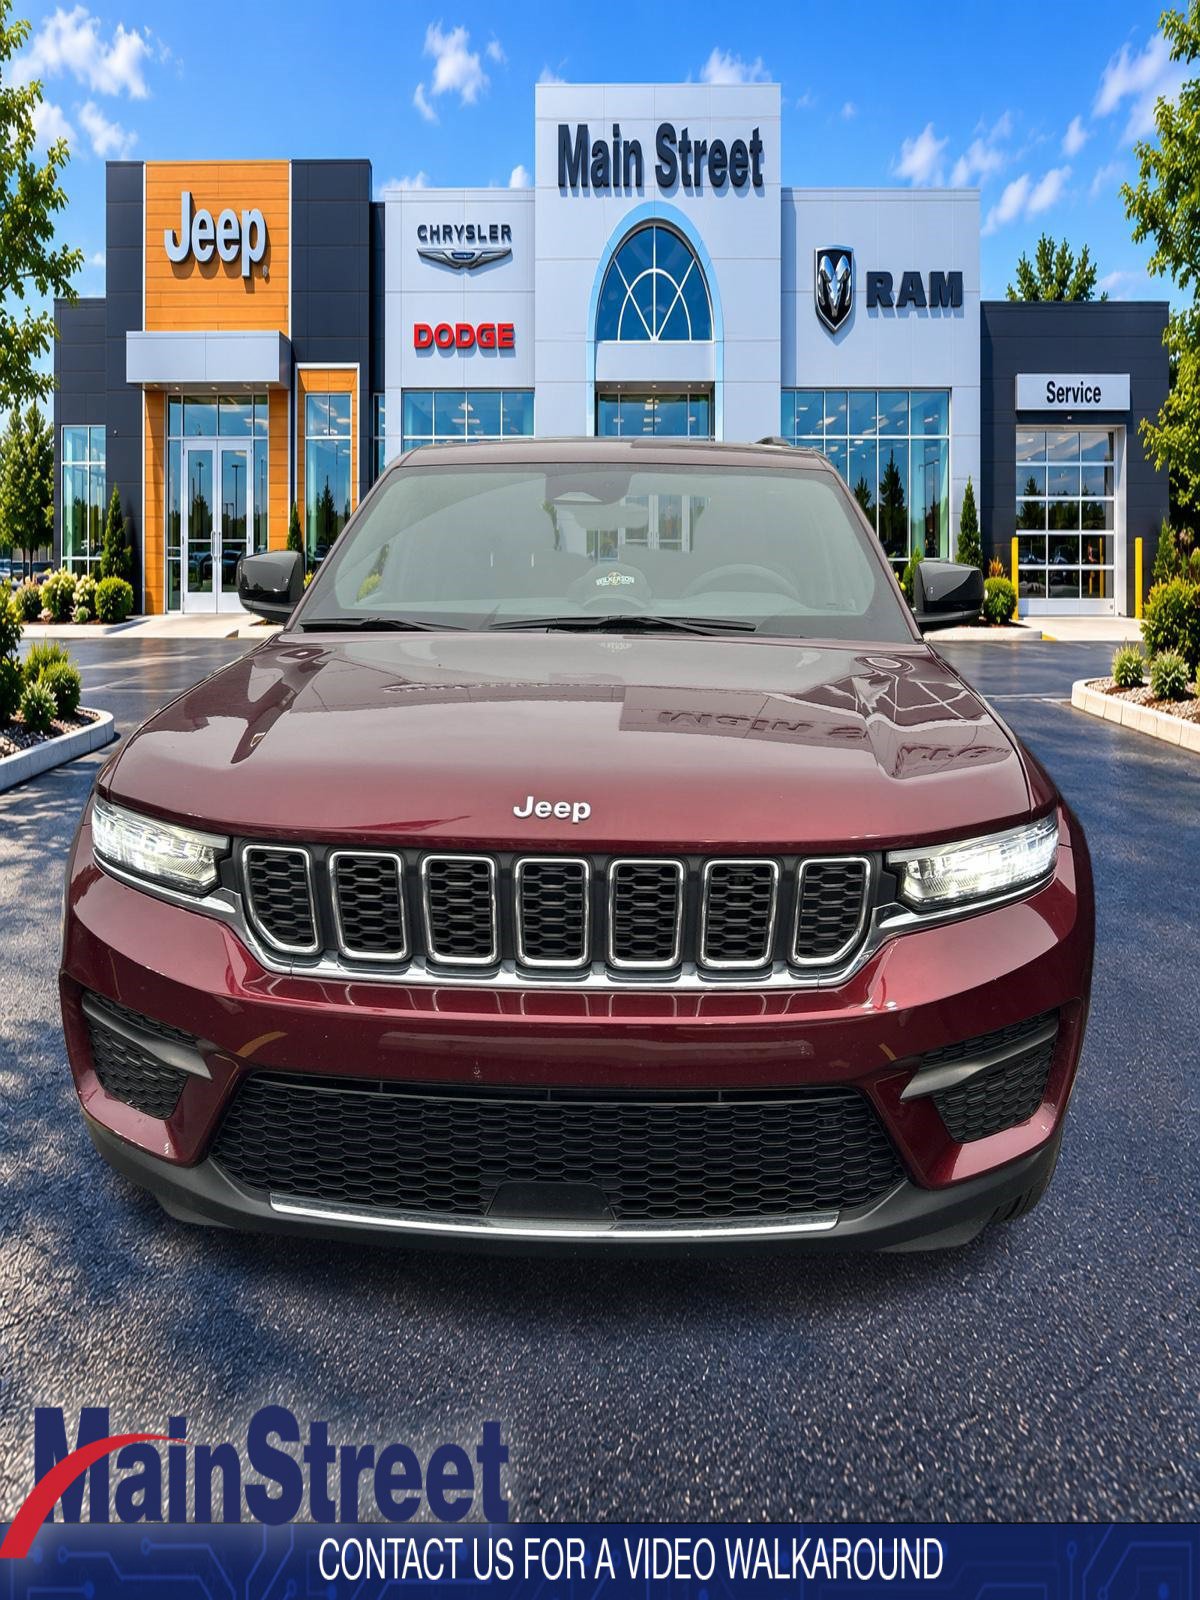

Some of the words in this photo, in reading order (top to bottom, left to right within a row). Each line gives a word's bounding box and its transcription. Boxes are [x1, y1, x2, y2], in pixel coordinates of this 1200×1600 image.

[557, 123, 643, 189] Main
[655, 122, 764, 189] Street
[164, 191, 266, 277] Jeep
[417, 224, 512, 243] CHRYSLER
[866, 271, 964, 309] RAM
[413, 323, 515, 349] DODGE
[1046, 380, 1102, 404] Service
[513, 795, 592, 824] Jeep
